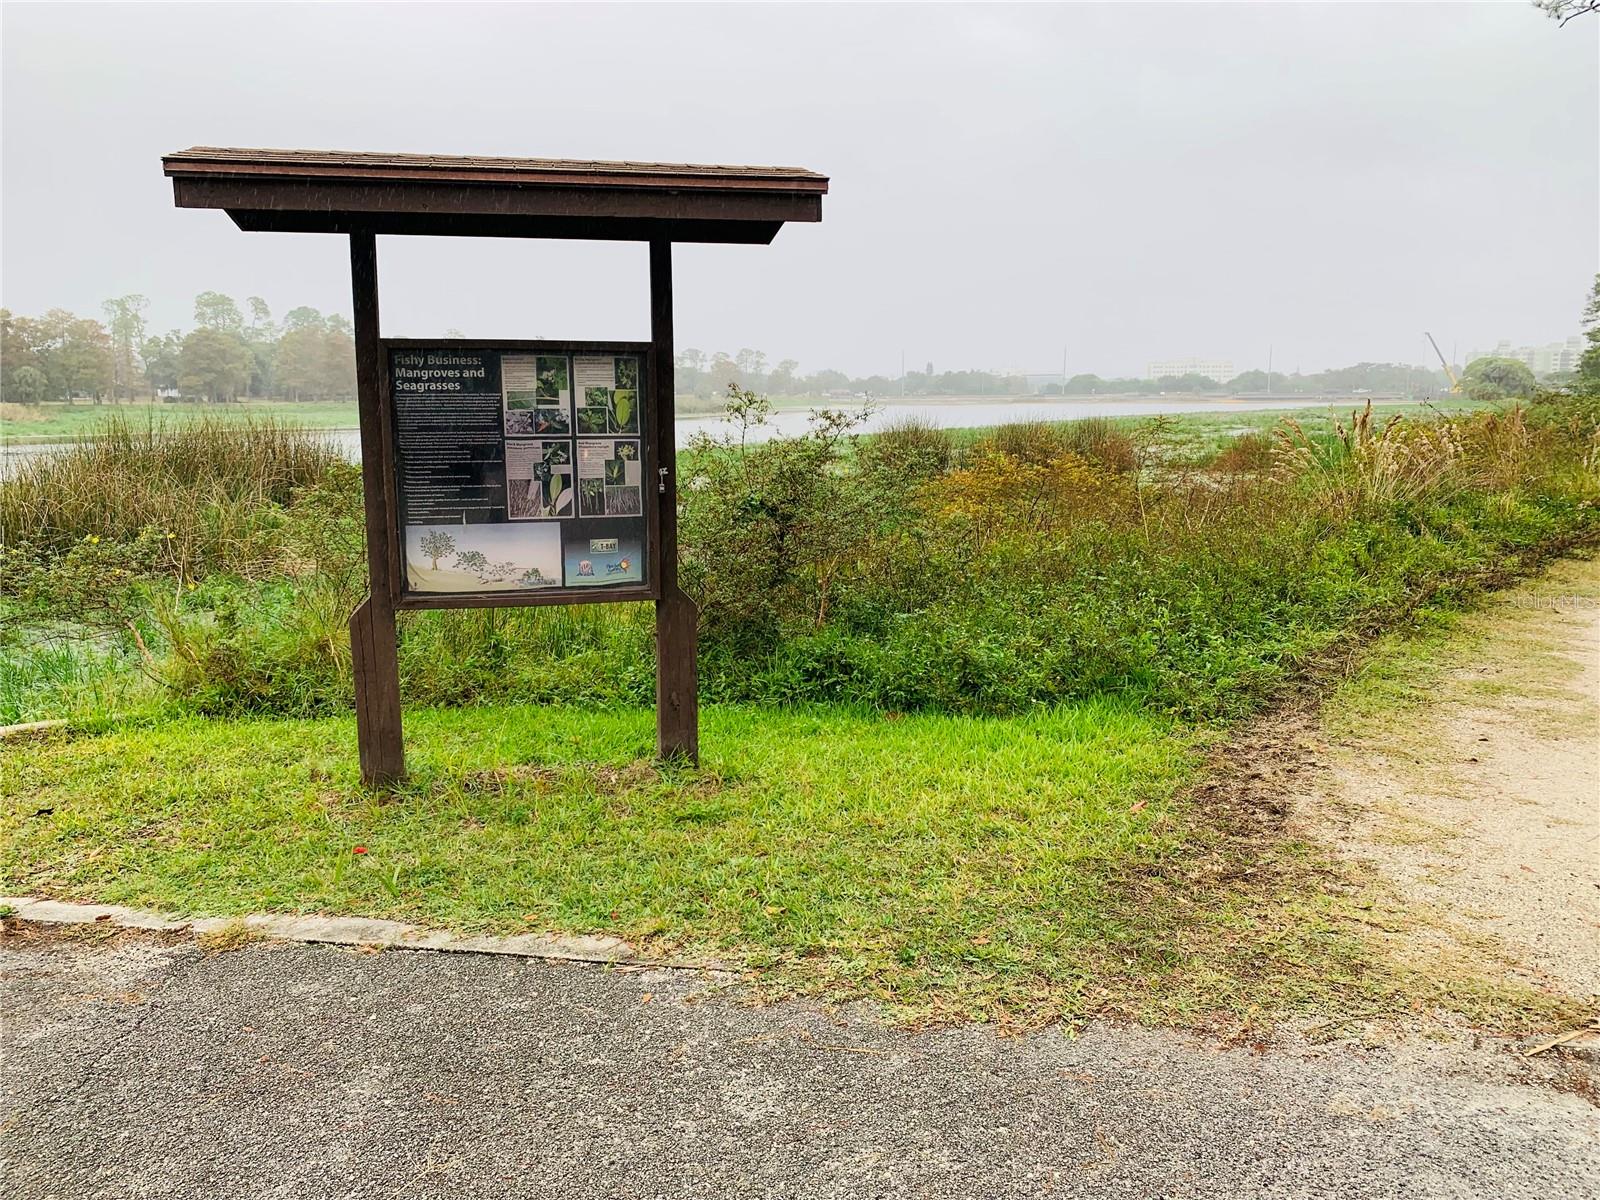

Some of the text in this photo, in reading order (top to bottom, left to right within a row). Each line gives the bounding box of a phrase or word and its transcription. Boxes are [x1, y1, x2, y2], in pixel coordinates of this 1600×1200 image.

[394, 354, 482, 367] Fishy Business:
[395, 367, 485, 380] Mangroves and
[395, 380, 461, 393] Seagrasses
